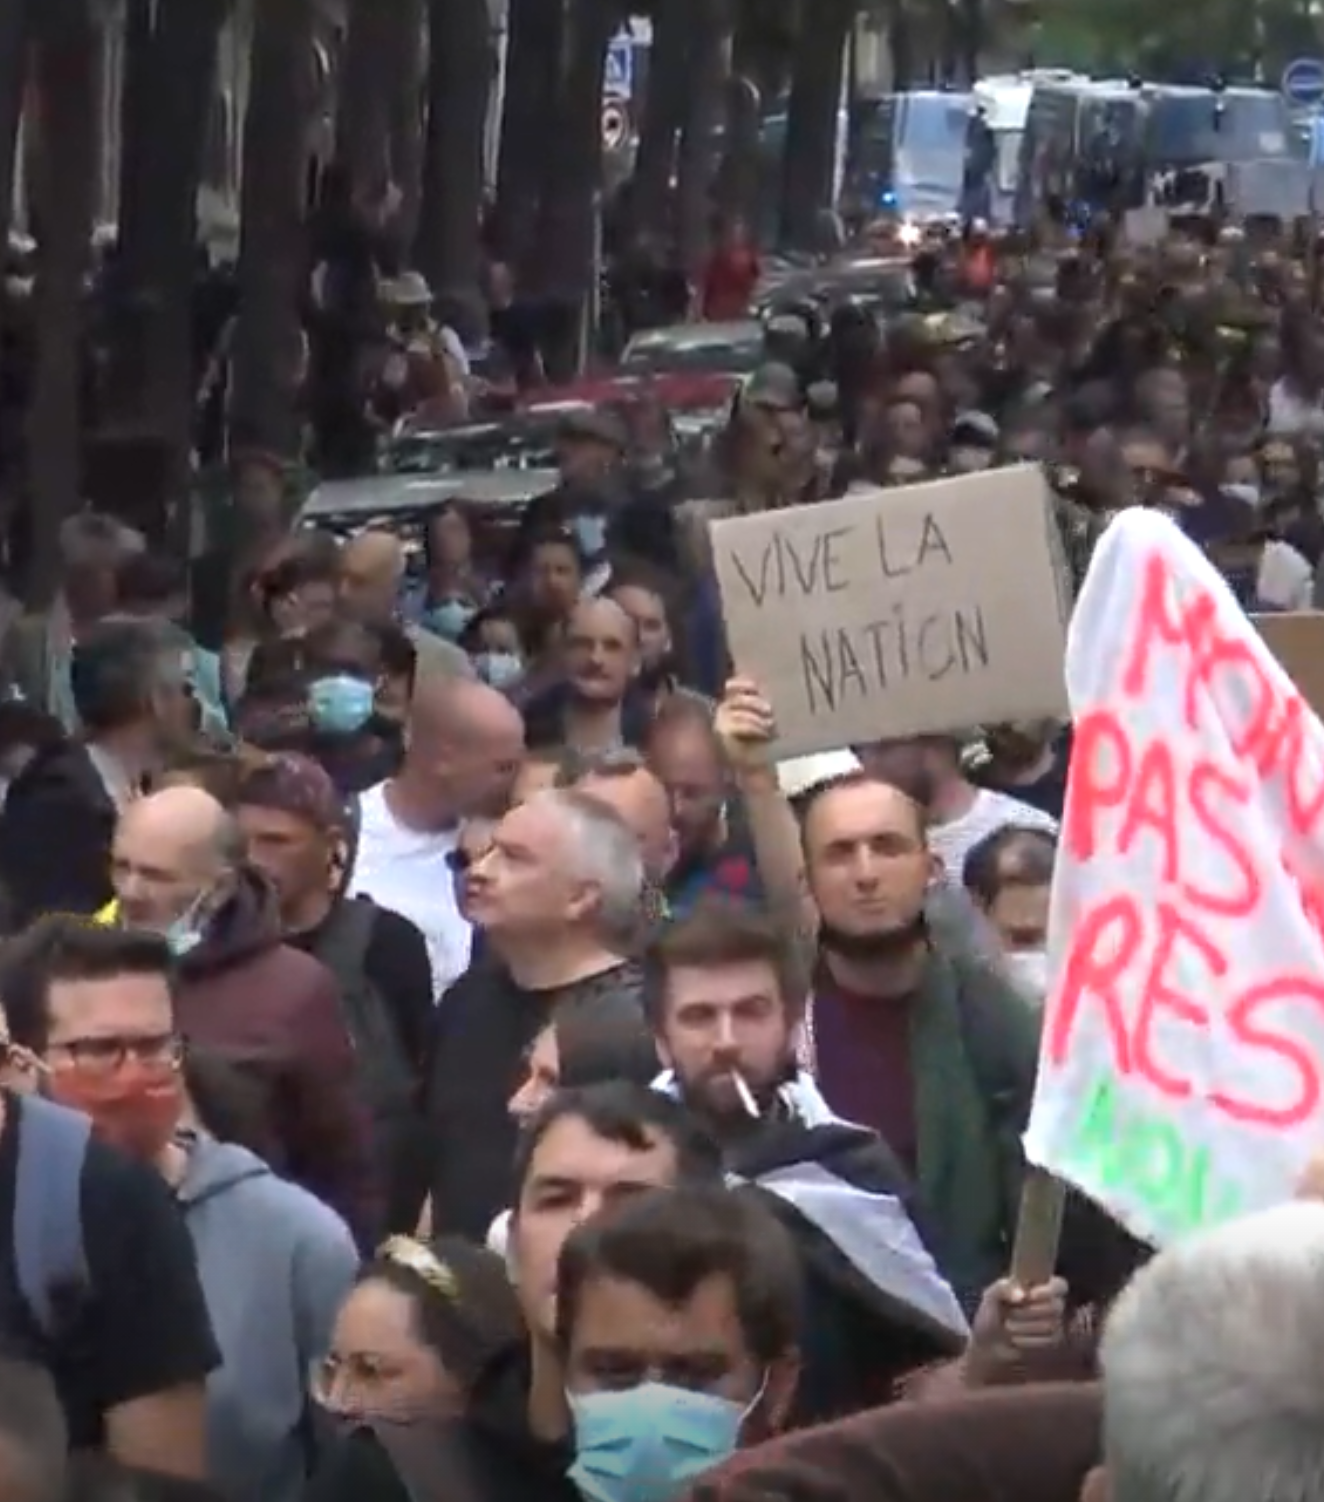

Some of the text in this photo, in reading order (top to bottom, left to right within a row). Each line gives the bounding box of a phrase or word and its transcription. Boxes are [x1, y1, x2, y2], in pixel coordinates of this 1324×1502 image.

[731, 512, 952, 607] VIVE LA
[1070, 710, 1263, 918] PAS
